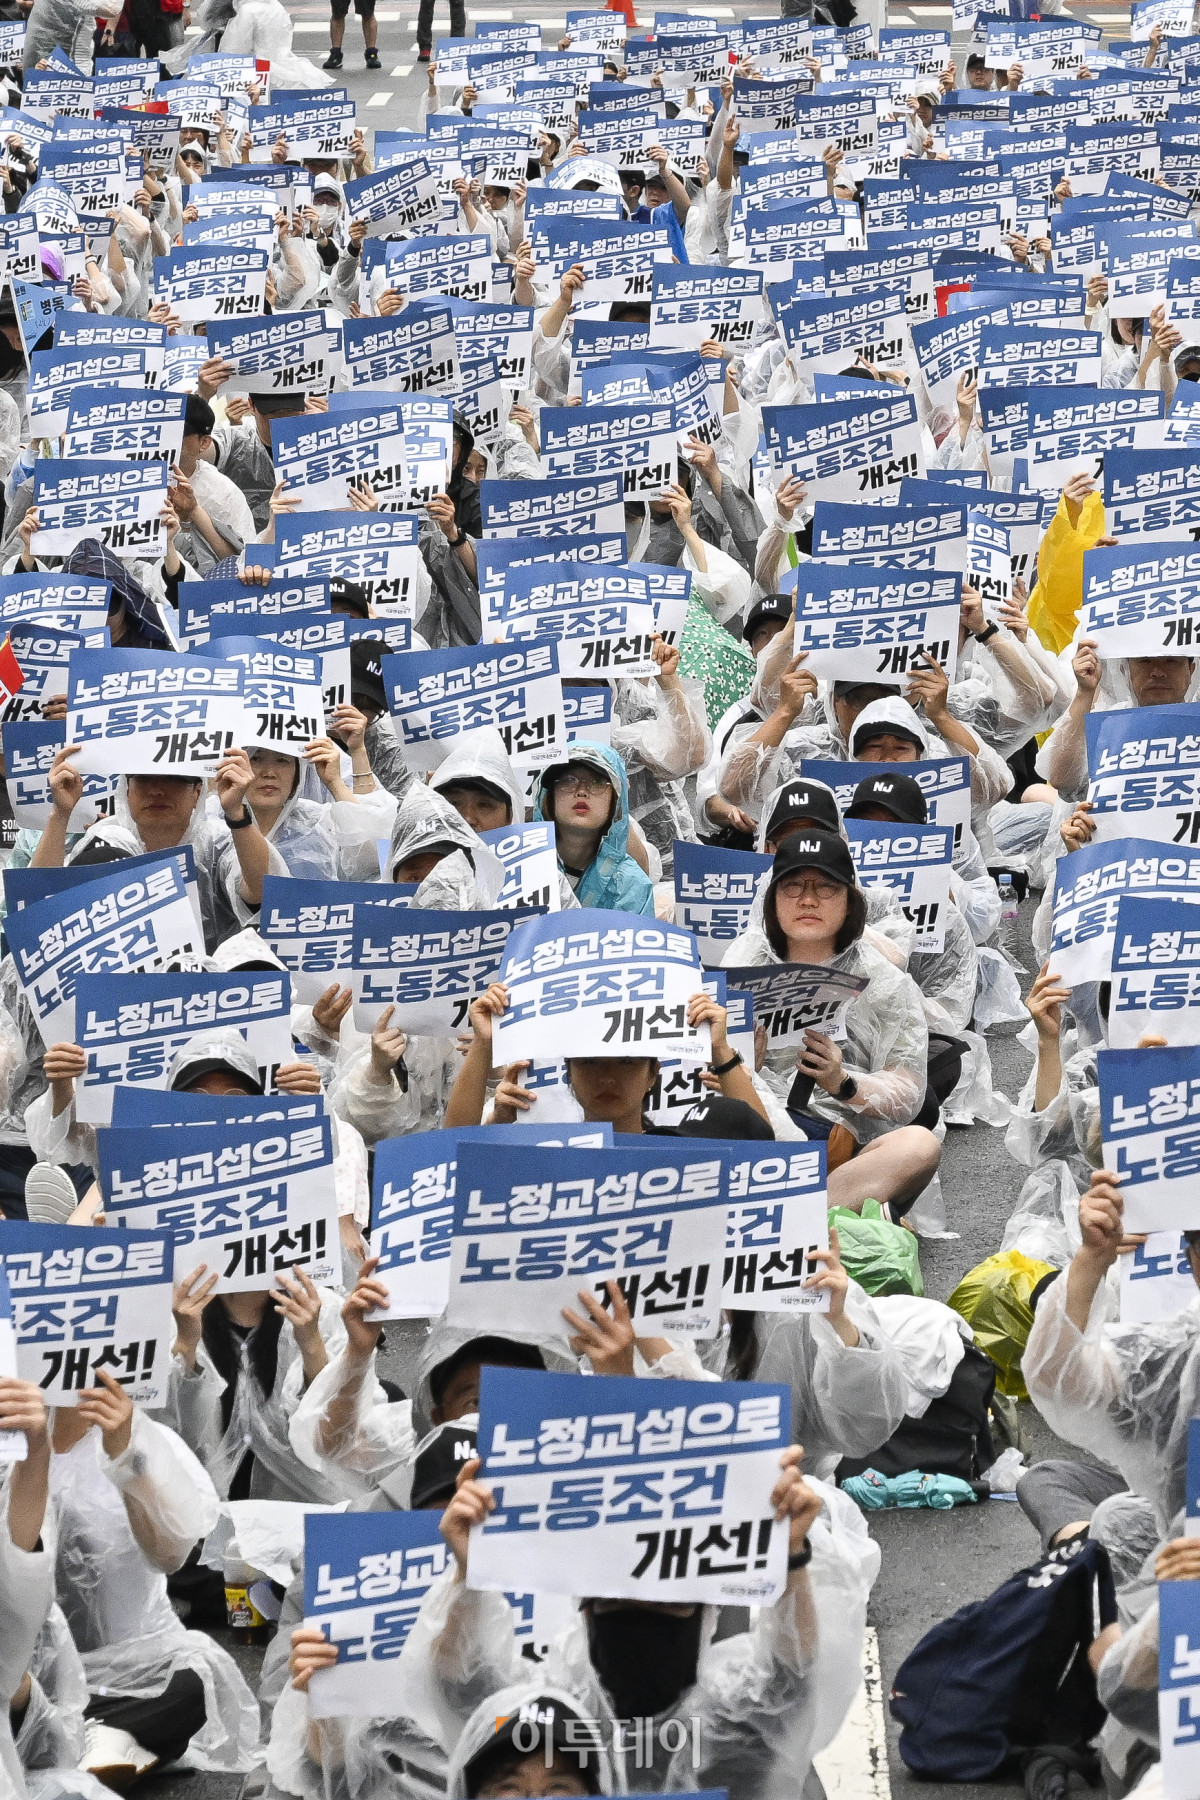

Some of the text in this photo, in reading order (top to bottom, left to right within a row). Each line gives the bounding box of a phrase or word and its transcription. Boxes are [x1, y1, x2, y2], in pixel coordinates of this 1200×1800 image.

[568, 13, 624, 29] 노정교섭으로
[744, 19, 809, 42] 노정교섭으로
[1018, 26, 1083, 46] 노정교섭으로
[661, 39, 726, 61] 노정교섭으로
[779, 47, 809, 63] 개선!
[881, 32, 946, 51] 노정교섭으로
[1018, 43, 1072, 61] 노동조건
[470, 54, 536, 76] 노정교섭으로
[1052, 55, 1083, 70] 개선!
[516, 86, 575, 103] 노정교섭으로
[736, 81, 812, 103] 노정교섭으로
[282, 103, 354, 125] 노정교섭으로
[580, 116, 657, 136] 노정교섭으로
[798, 100, 874, 122] 노정교섭으로
[1013, 100, 1089, 122] 노정교섭으로
[283, 122, 342, 141] 노동조건
[800, 119, 859, 140] 노동조건
[835, 133, 873, 151] 개선!
[1070, 131, 1158, 156] 노정교섭으로
[744, 165, 824, 195] 노정교섭으로
[1068, 152, 1140, 176] 노동조건
[350, 160, 429, 212] 노정교섭으로
[923, 180, 1014, 205] 노정교섭으로
[399, 199, 438, 226] 개선!
[528, 195, 617, 216] 노정교섭으로
[580, 229, 669, 259] 노정교섭으로
[750, 216, 844, 243] 노정교섭으로
[171, 252, 266, 280] 노정교섭으로
[389, 238, 488, 273] 노정교섭으로
[828, 252, 929, 285] 노정교섭으로
[172, 276, 246, 301] 노동조건
[655, 275, 760, 300] 노정교섭으로
[214, 295, 260, 314] 개선!
[654, 300, 741, 326] 노동조건
[799, 296, 903, 337] 노정교섭으로
[57, 328, 163, 346] 노정교섭으로
[214, 315, 322, 358] 노정교섭으로
[349, 313, 449, 356] 노정교섭으로
[710, 320, 755, 342] 개선!
[800, 322, 885, 360] 노동조건
[353, 344, 432, 386] 노동조건
[983, 335, 1098, 365] 노정교섭으로
[32, 354, 141, 390] 노정교섭으로
[272, 360, 324, 388] 개선!
[400, 359, 454, 393] 개선!
[71, 398, 183, 432] 노정교섭으로
[547, 410, 672, 451] 노정교섭으로
[786, 399, 912, 454] 노정교섭으로
[1033, 395, 1160, 434] 노정교섭으로
[68, 425, 162, 458] 노동조건
[278, 412, 399, 462] 노정교섭으로
[1034, 428, 1135, 464] 노동조건
[282, 443, 379, 491] 노동조건
[548, 441, 649, 480] 노동조건
[793, 434, 894, 483] 노동조건
[858, 453, 919, 491] 개선!
[38, 465, 164, 501] 노정교섭으로
[37, 497, 140, 530] 노동조건
[487, 479, 619, 524] 노정교섭으로
[100, 517, 161, 549] 개선!
[280, 521, 413, 560] 노정교섭으로
[818, 509, 962, 552] 노정교섭으로
[330, 584, 345, 593] NJ
[509, 572, 648, 615] 노정교섭으로
[762, 600, 778, 610] NJ
[803, 576, 956, 614] 노정교섭으로
[505, 605, 627, 643] 노동조건
[800, 611, 928, 651] 노동조건
[75, 665, 239, 705] 노정교섭으로
[393, 648, 553, 708] 노정교섭으로
[72, 699, 209, 744] 노동조건
[256, 713, 318, 742] 개선!
[402, 686, 528, 746] 노동조건
[152, 730, 234, 764] 개선!
[789, 793, 809, 806] NJ
[873, 781, 893, 793] NJ
[800, 841, 820, 853] NJ
[19, 867, 179, 978] 노정교섭으로
[504, 927, 693, 983] 노정교섭으로
[82, 979, 284, 1042] 노정교섭으로
[499, 968, 665, 1030] 노동조건
[110, 1126, 326, 1203] 노정교섭으로
[461, 1158, 723, 1227] 노정교섭으로
[223, 1218, 328, 1278] 개선!
[459, 1219, 673, 1284] 노동조건
[38, 1338, 157, 1391] 개선!
[485, 1395, 782, 1470] 노정교섭으로
[481, 1465, 728, 1537] 노동조건
[631, 1518, 774, 1582] 개선!
